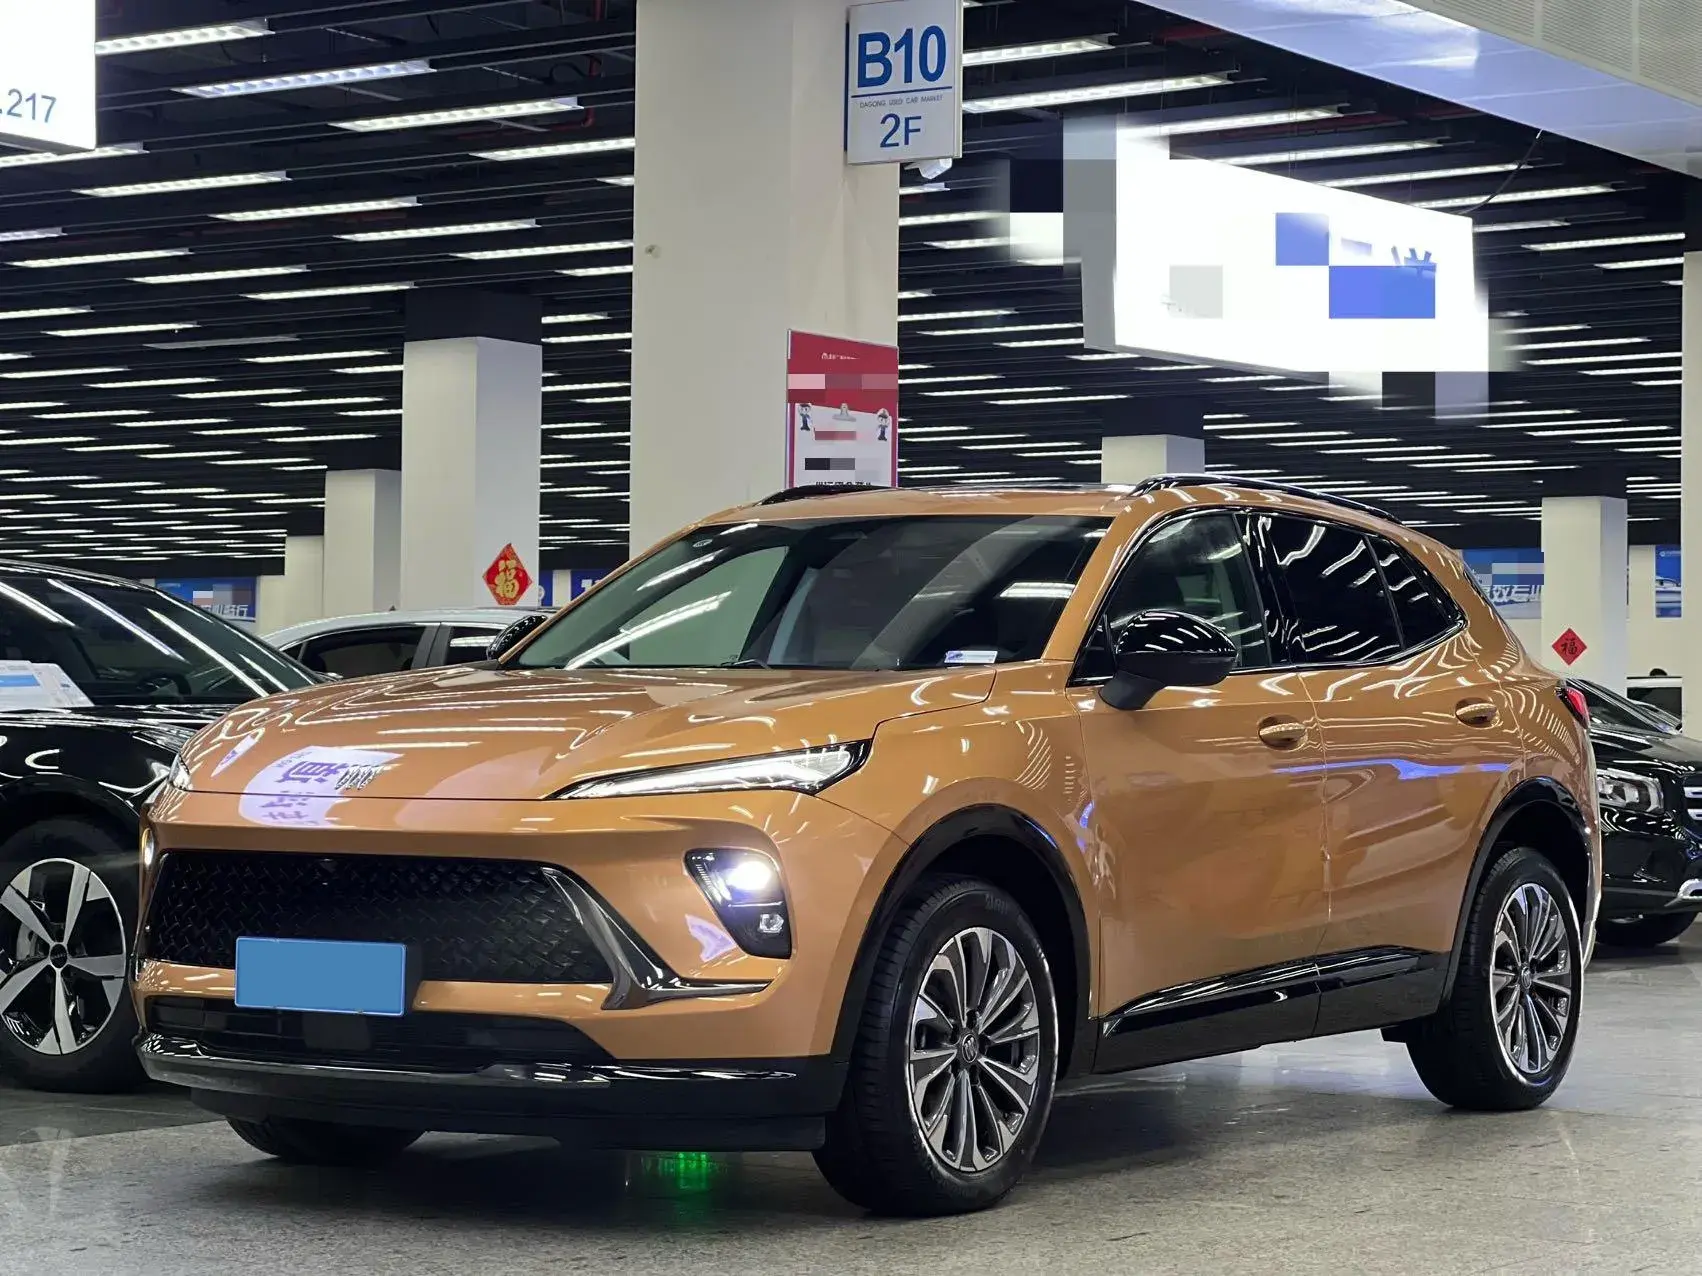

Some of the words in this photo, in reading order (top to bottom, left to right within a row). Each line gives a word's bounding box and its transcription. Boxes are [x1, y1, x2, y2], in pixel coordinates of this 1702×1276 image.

[857, 25, 947, 88] B10
[889, 98, 903, 106] USED
[905, 96, 919, 104] CAR
[920, 94, 944, 103] MARKET
[880, 113, 922, 148] 2F
[1560, 637, 1578, 655] 福
